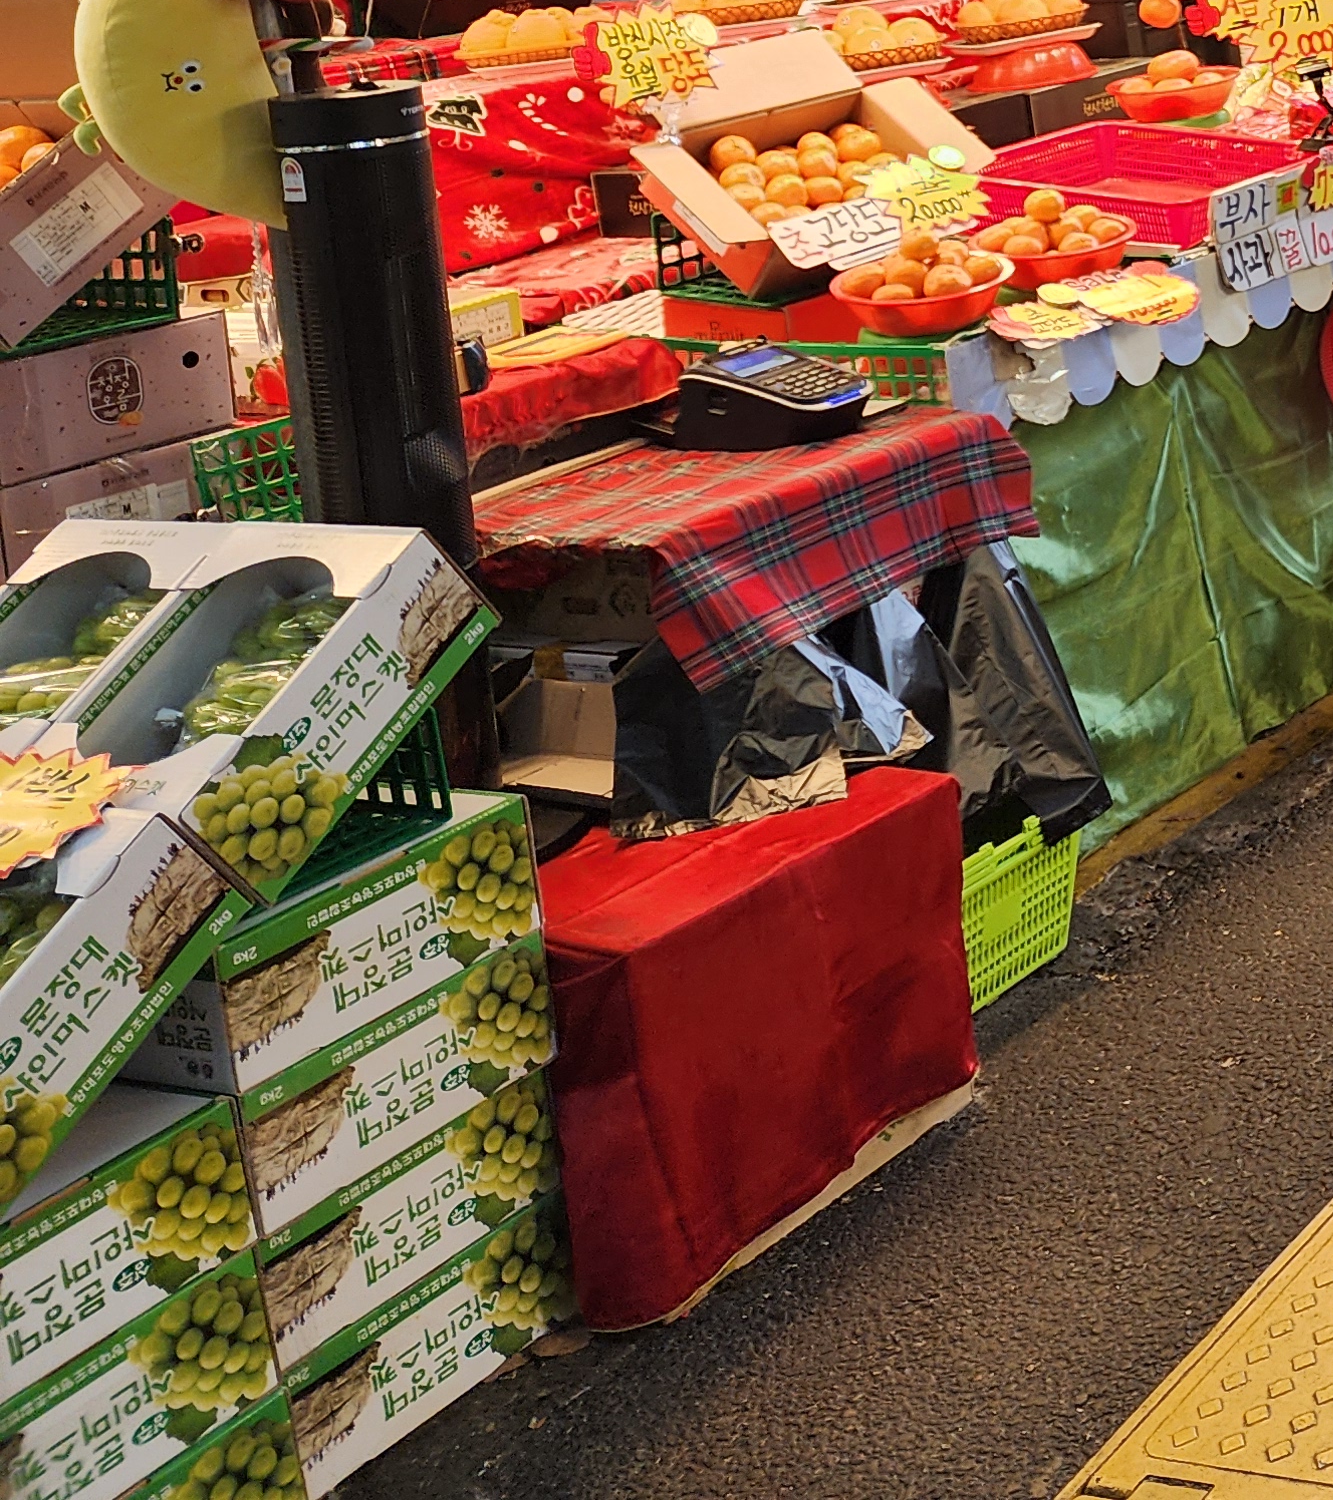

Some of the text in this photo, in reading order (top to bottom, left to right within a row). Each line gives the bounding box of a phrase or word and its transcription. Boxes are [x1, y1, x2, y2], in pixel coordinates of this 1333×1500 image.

[1218, 183, 1272, 239] 부사
[1227, 233, 1275, 287] 사과
[308, 632, 386, 724] 문장대
[294, 651, 411, 786] 샤인머스켓
[18, 935, 109, 1038] 문장대
[332, 947, 414, 1014] 문장대
[357, 1081, 437, 1150] 문장대
[364, 1216, 442, 1288] 문장대
[382, 1353, 459, 1424] 문장대
